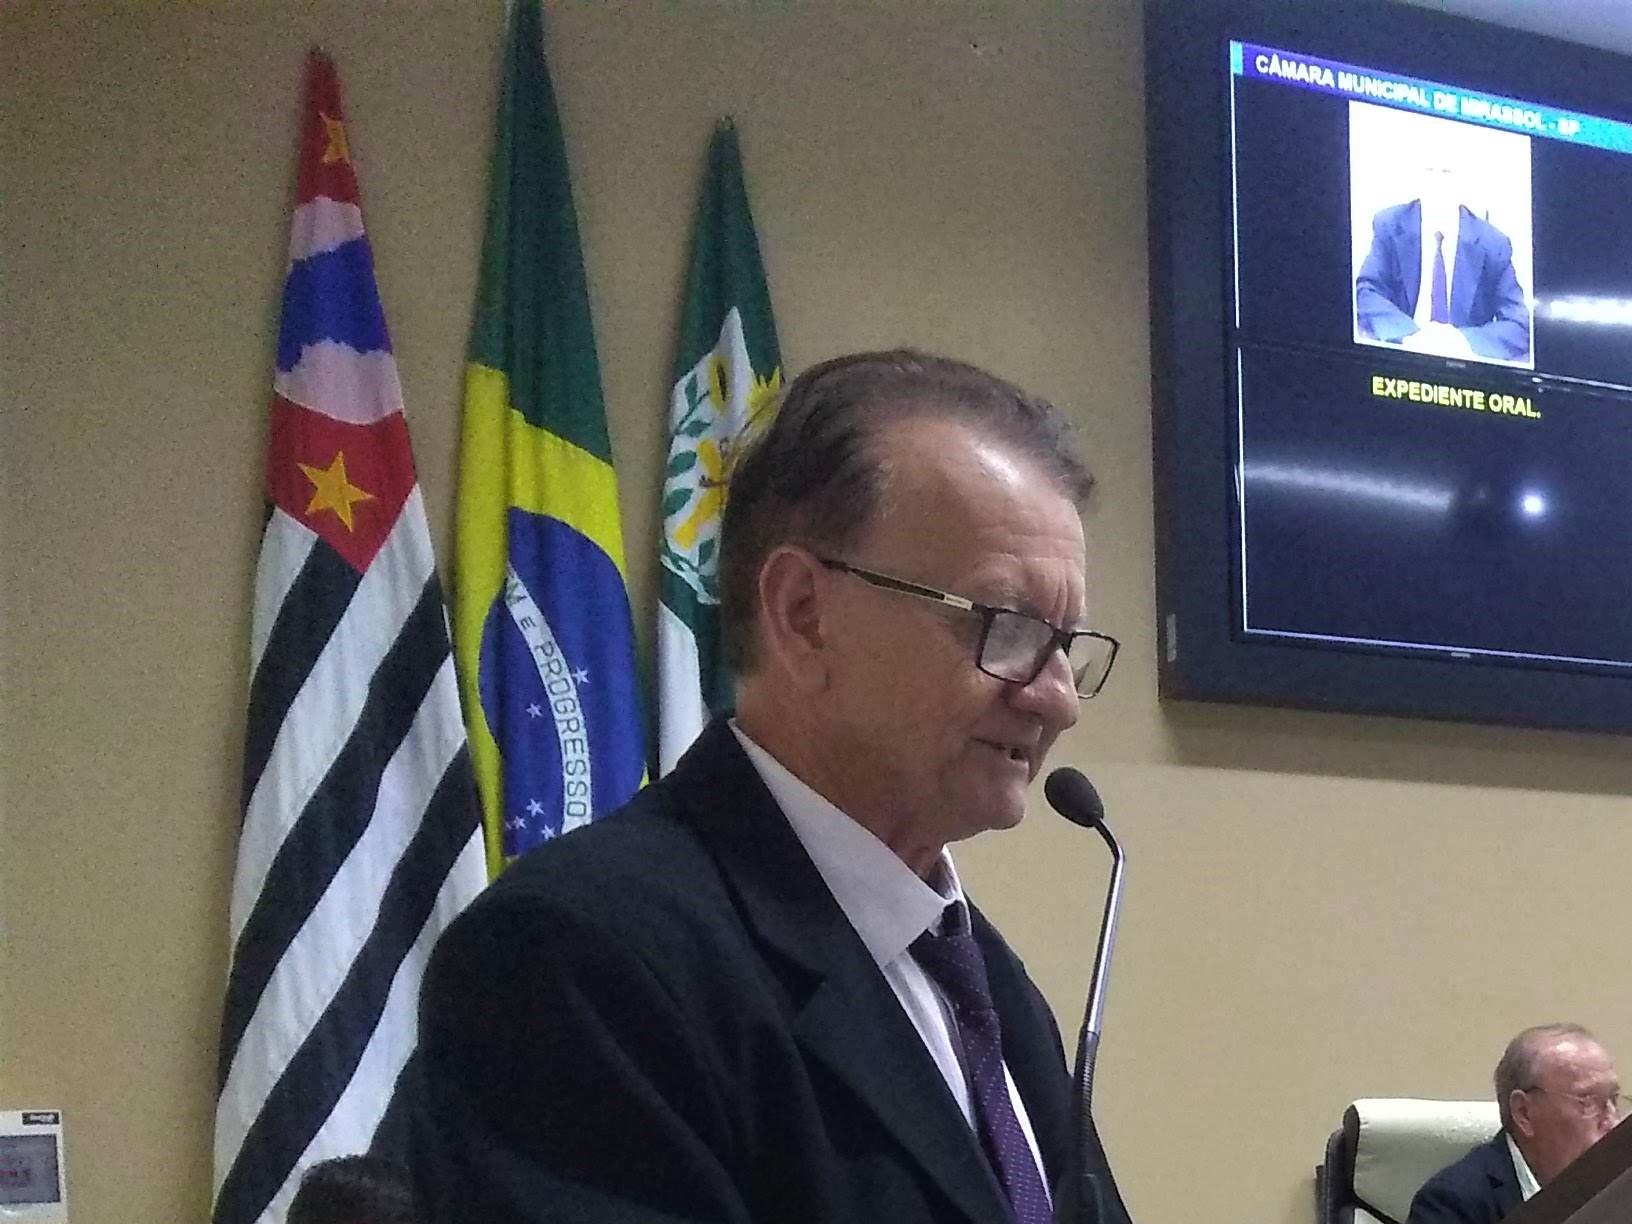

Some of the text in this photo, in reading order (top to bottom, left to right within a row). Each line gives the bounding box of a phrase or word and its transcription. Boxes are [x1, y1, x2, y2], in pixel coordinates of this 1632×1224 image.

[1256, 54, 1335, 88] CÂMARA
[1338, 71, 1429, 107] MUNICIPAL
[1433, 91, 1458, 113] DE
[1372, 375, 1541, 419] EXPEDIENTE ORAL.
[535, 641, 588, 818] PROGRESSO
